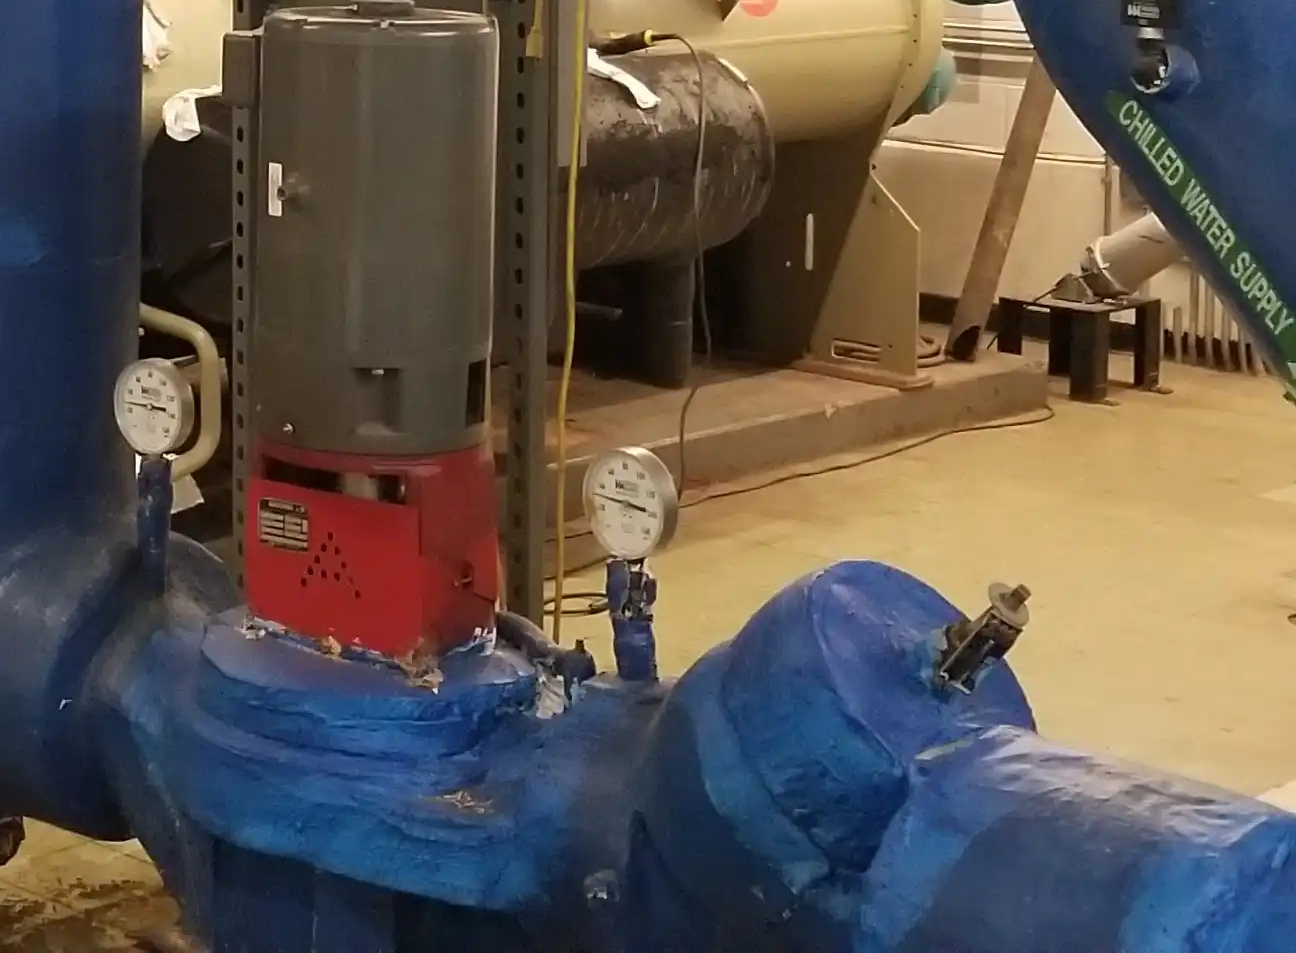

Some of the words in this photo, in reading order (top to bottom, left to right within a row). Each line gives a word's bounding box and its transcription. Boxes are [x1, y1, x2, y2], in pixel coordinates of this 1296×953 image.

[1119, 99, 1184, 186] CHILLED
[1180, 178, 1235, 259] WATER
[1230, 252, 1295, 336] SUPPLY
